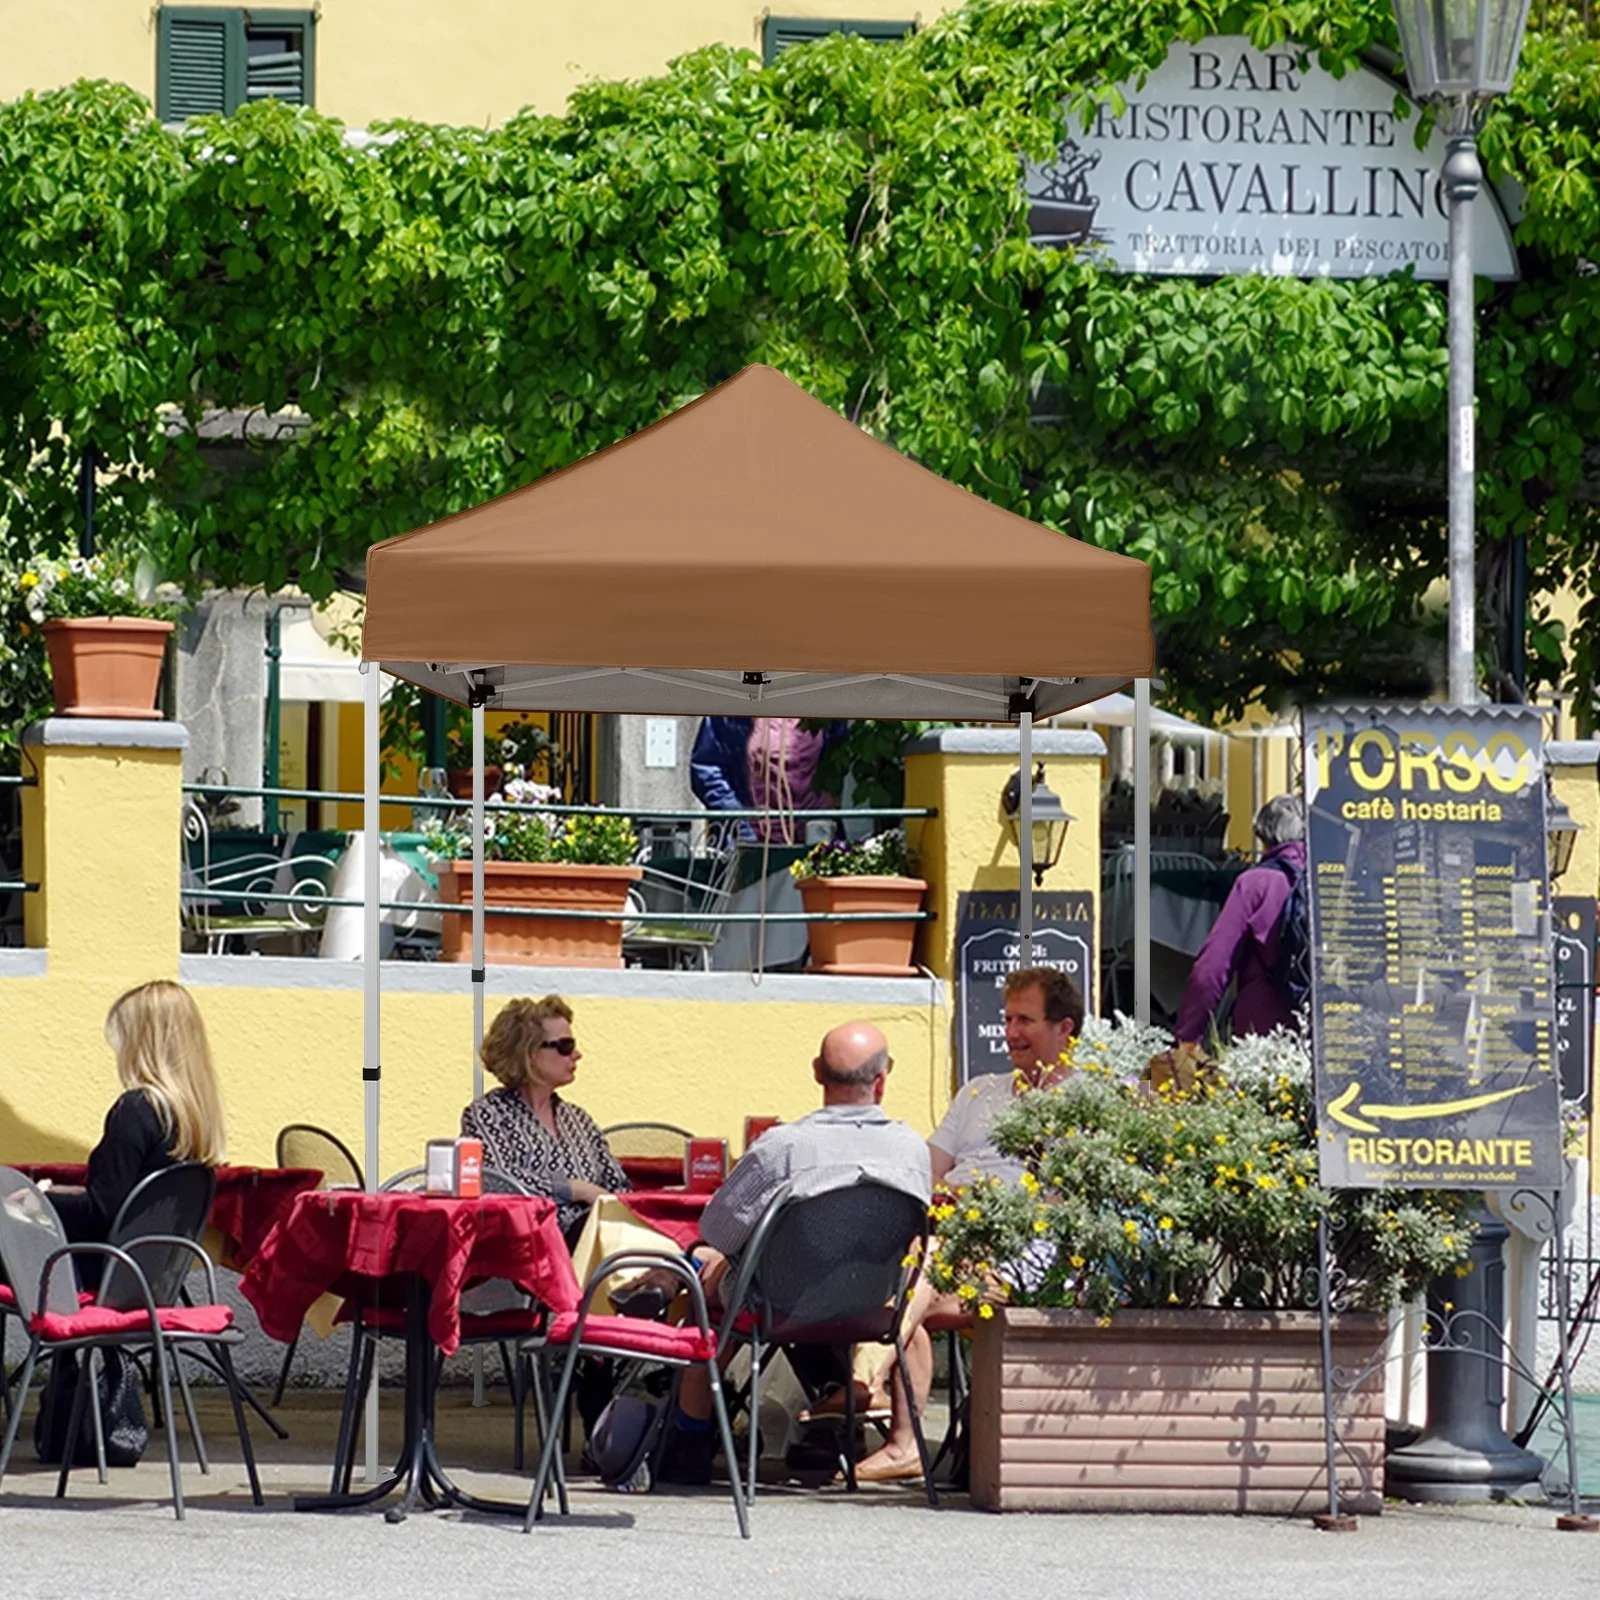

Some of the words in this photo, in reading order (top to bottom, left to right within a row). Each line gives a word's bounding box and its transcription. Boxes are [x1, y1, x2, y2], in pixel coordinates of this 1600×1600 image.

[1190, 51, 1300, 91] BAR
[1094, 103, 1395, 147] RISTORANTE
[1128, 232, 1264, 257] TRATTORIA
[1279, 237, 1321, 258] DEI
[1341, 796, 1396, 820] cafè
[1401, 798, 1502, 822] hostaria
[968, 902, 1089, 921] TRATORIA
[1347, 1138, 1533, 1166] RISTORANTE
